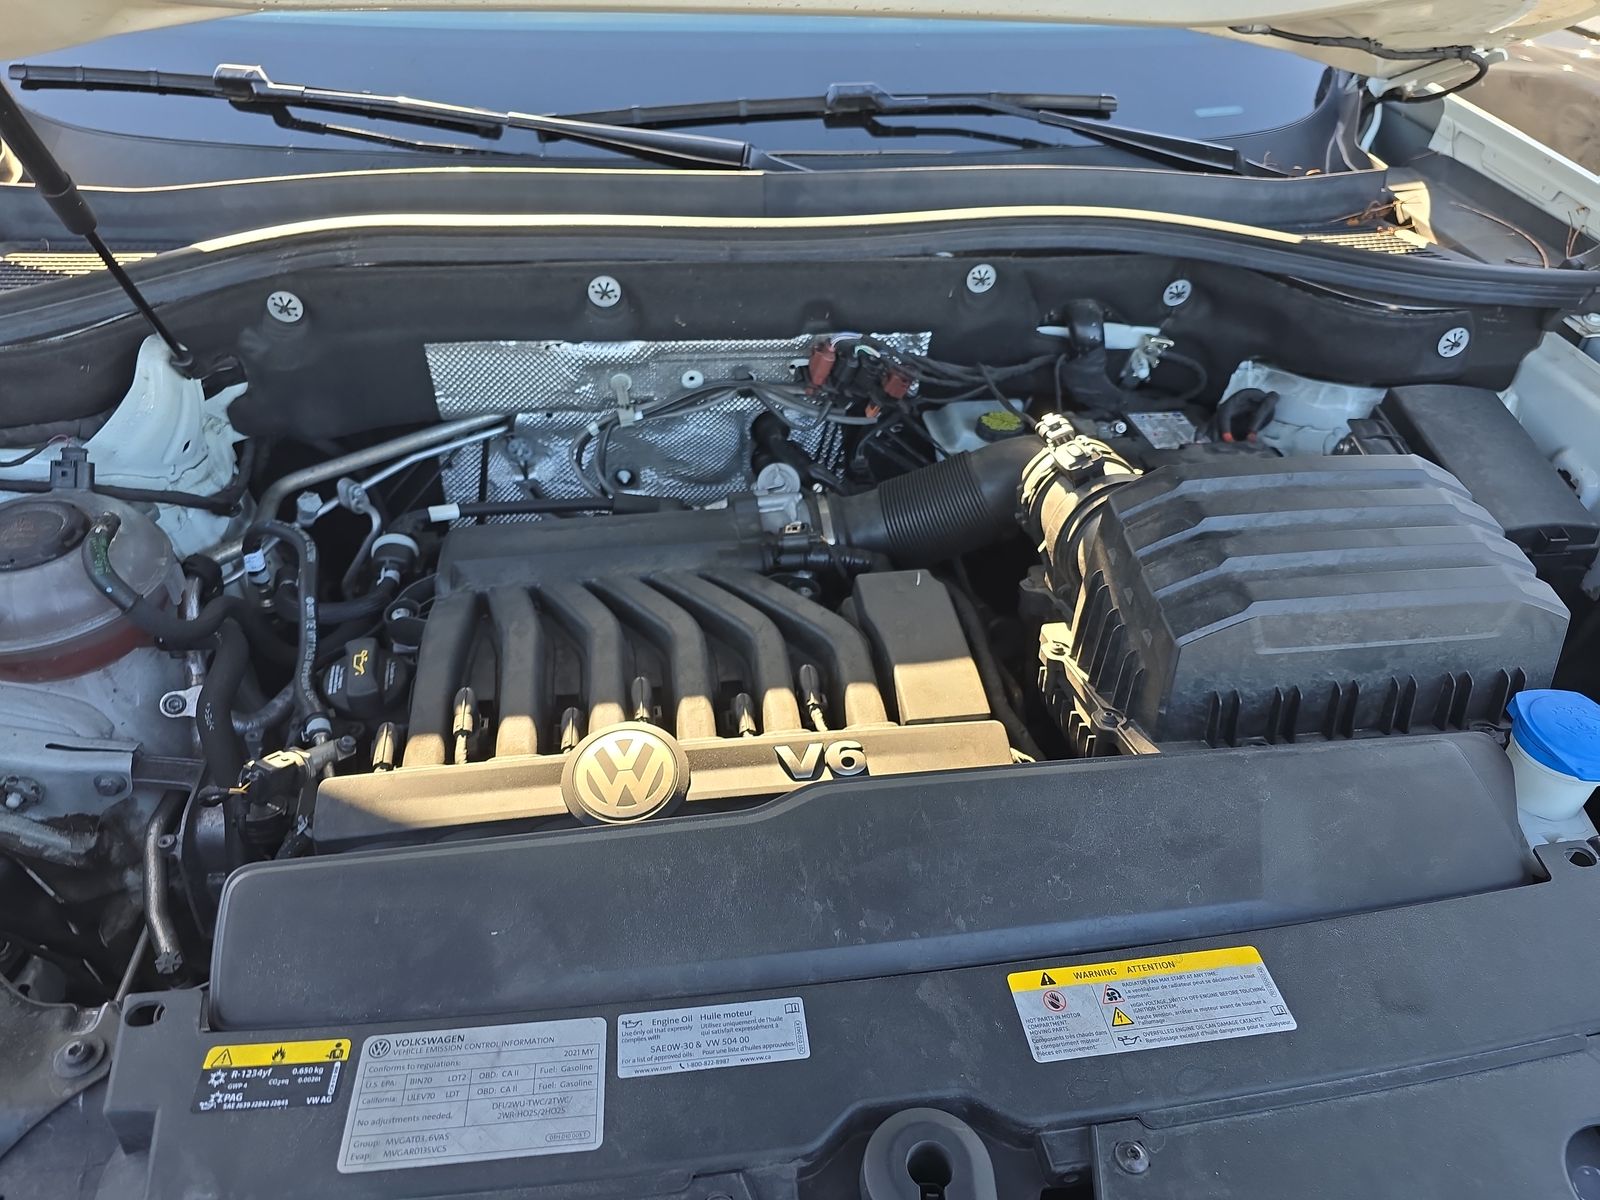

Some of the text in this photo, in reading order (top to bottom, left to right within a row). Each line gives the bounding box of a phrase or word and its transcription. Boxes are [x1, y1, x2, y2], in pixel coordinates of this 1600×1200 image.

[773, 740, 868, 781] V6
[580, 734, 670, 812] VW
[1073, 961, 1175, 979] WARNING ATTENTION
[700, 1010, 752, 1020] Huile moteur
[652, 1017, 679, 1027] Engine
[723, 1019, 757, 1028] uniquement
[711, 1027, 733, 1035] satisfait
[735, 1024, 773, 1033] expressément
[394, 1034, 465, 1047] VOLKSWAGEN
[722, 1037, 737, 1045] 504
[1032, 1035, 1064, 1043] Composants
[426, 1045, 462, 1053] EMISSION
[464, 1040, 500, 1050] CONTROL
[502, 1037, 554, 1047] INFORMATION
[1041, 1041, 1079, 1050] compartiment
[564, 1048, 580, 1057] 2021
[654, 1053, 681, 1061] approved
[231, 1066, 323, 1079] R-1234yf 0.650 kg
[368, 1064, 405, 1073] Conforms
[410, 1076, 433, 1085] BIN70
[448, 1074, 466, 1082] LDT2
[540, 1065, 558, 1074] Fuel:
[561, 1063, 592, 1073] Gasoline
[407, 1093, 435, 1101] ULEV70
[477, 1087, 496, 1095] OBD:
[500, 1085, 512, 1093] CA
[539, 1081, 557, 1090] Fuel:
[560, 1079, 592, 1088] Gasoline
[224, 1092, 243, 1102] PAG
[321, 1096, 332, 1104] AG
[371, 1114, 419, 1127] adjustments
[422, 1112, 453, 1120] needed.
